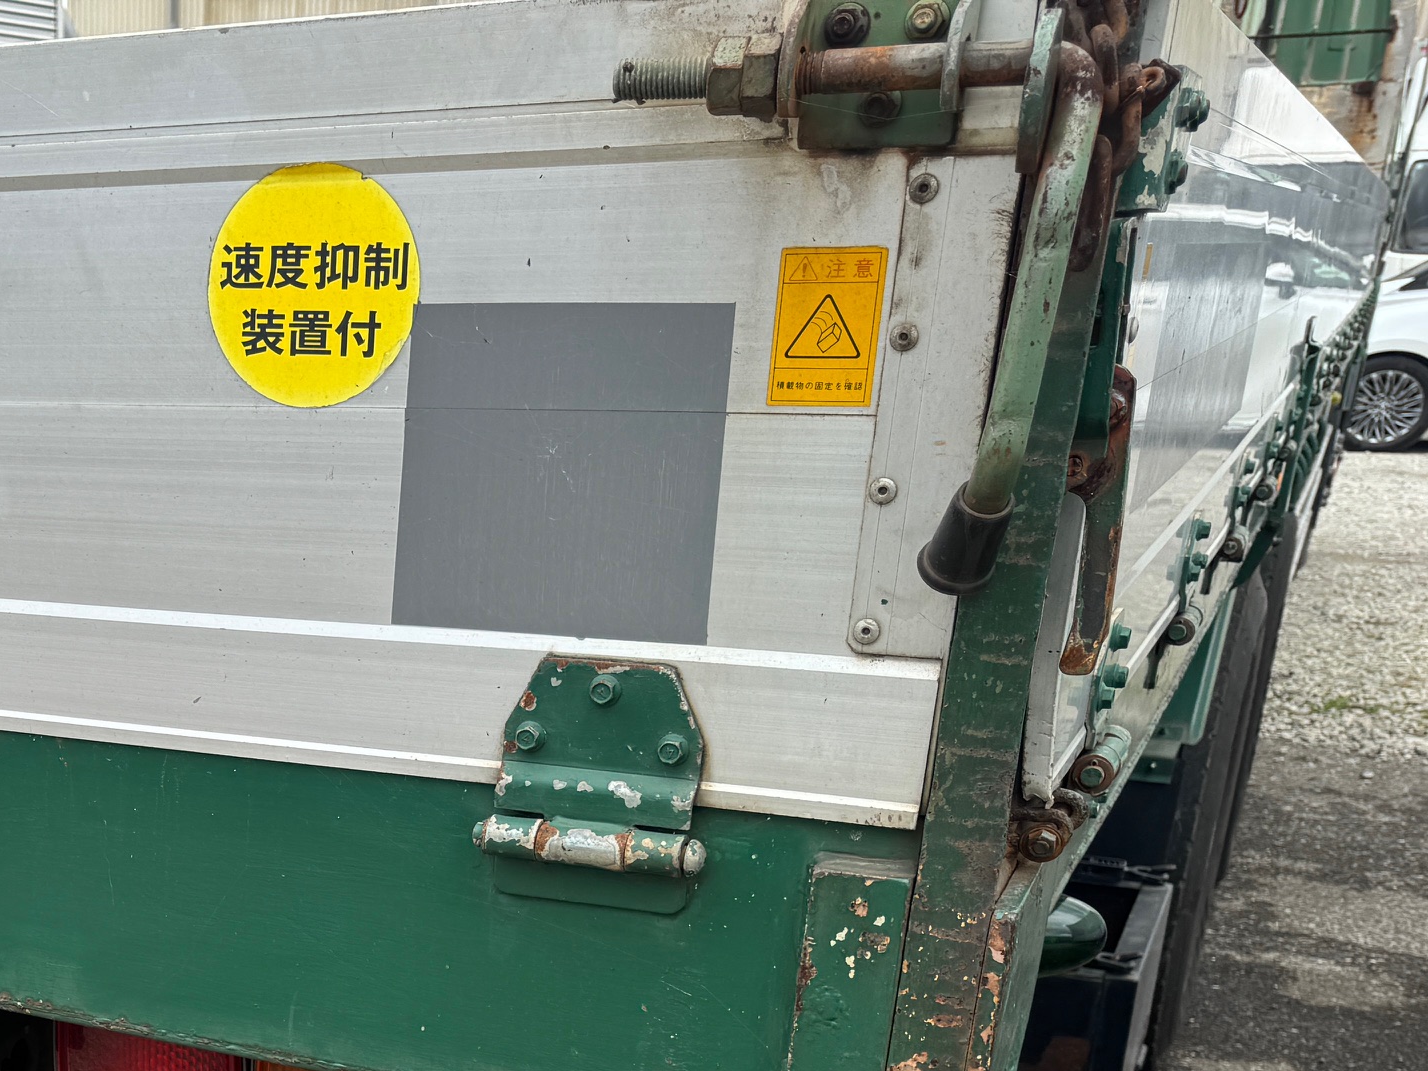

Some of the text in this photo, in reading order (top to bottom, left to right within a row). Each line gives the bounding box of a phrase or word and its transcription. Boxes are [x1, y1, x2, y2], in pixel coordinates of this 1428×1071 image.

[220, 242, 409, 291] 速度抑制
[826, 258, 874, 279] 注意
[241, 308, 381, 358] 装置付
[776, 380, 863, 391] 積載物の固定を確認
